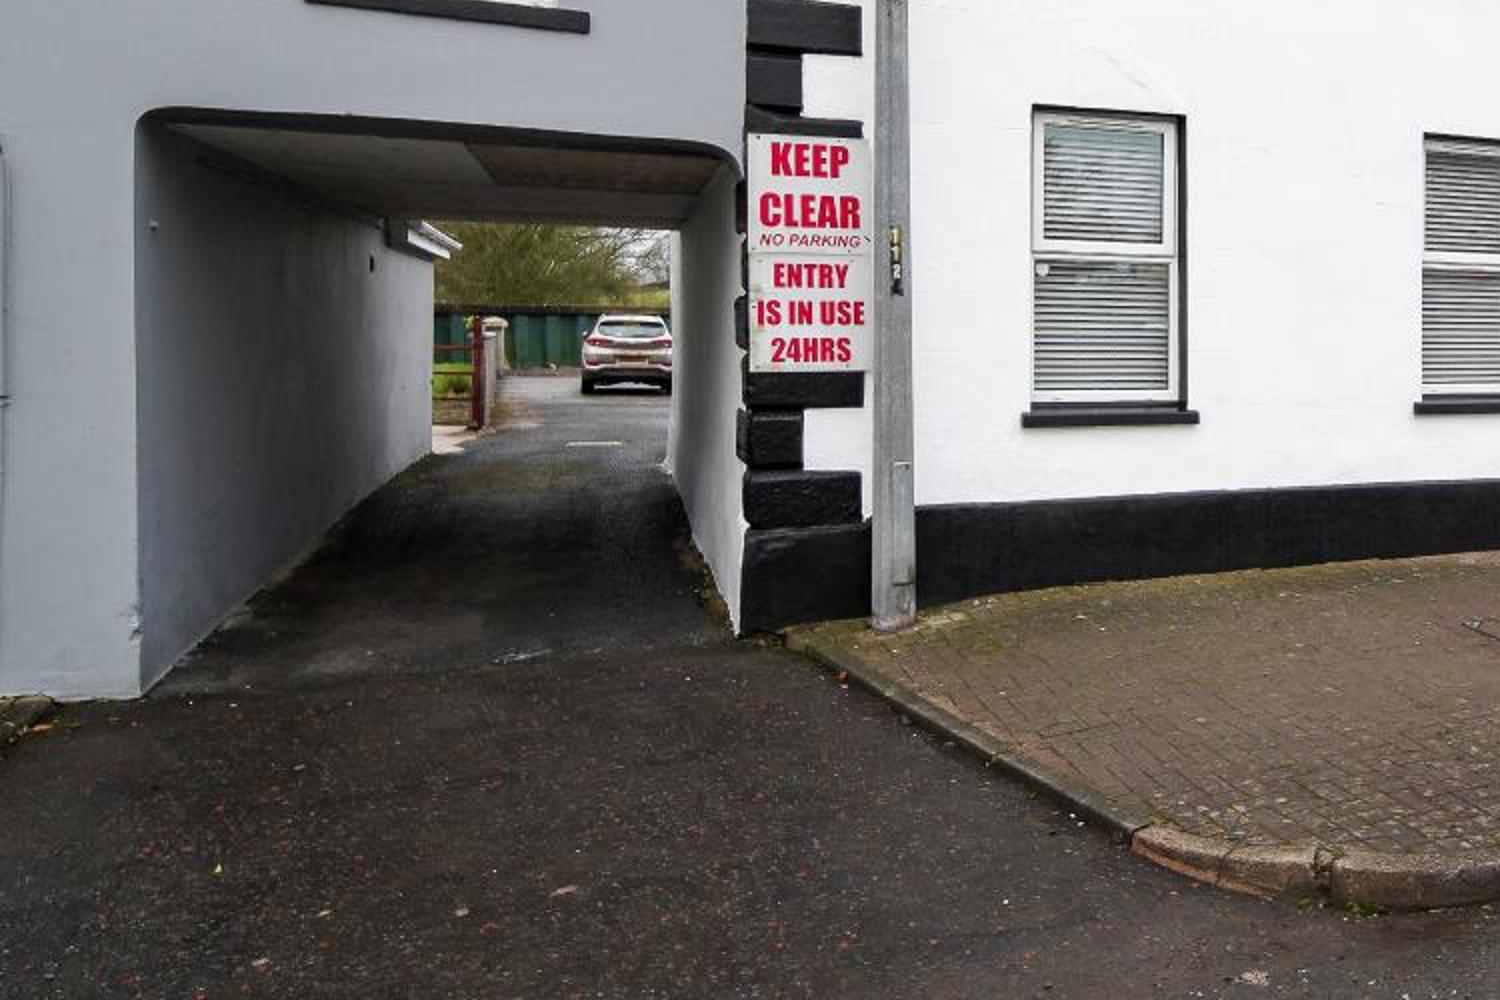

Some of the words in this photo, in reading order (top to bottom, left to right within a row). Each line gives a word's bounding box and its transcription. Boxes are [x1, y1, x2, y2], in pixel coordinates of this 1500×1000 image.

[770, 142, 849, 178] KEEP
[759, 192, 861, 229] CLEAR
[759, 233, 785, 247] NO
[789, 234, 862, 248] PARKING
[773, 263, 849, 288] ENTRY
[757, 300, 781, 325] IS
[789, 301, 813, 325] IN
[820, 301, 865, 325] USE
[771, 337, 852, 363] 24HRS
